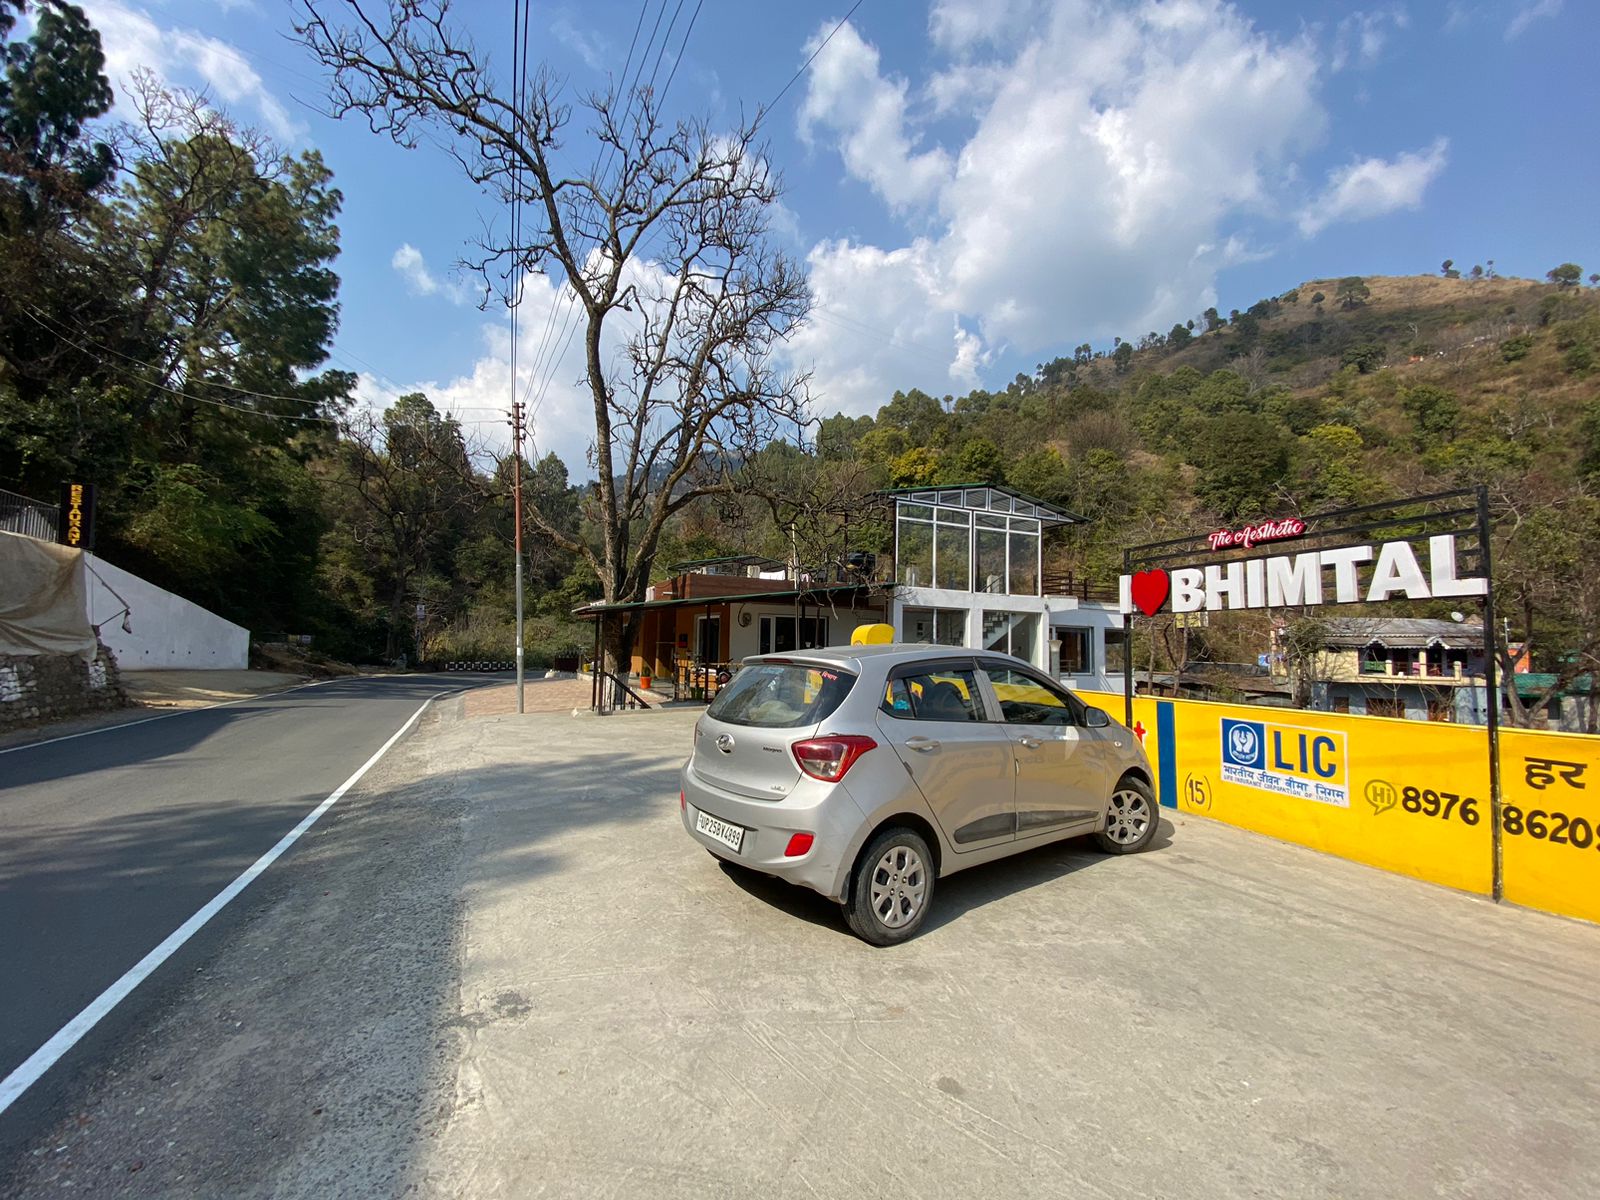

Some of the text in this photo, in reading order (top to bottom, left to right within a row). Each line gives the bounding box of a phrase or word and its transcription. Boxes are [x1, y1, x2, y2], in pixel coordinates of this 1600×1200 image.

[68, 484, 83, 545] RESTAURANT
[1208, 518, 1302, 550] The Aesthetic
[1119, 534, 1488, 614] I BHIMTAL
[1273, 730, 1336, 778] LIC
[1223, 764, 1345, 801] भारतीय जीवन बीमा निगम
[1524, 756, 1588, 790] हर
[1304, 791, 1312, 799] OF
[1372, 785, 1392, 805] Hi
[1401, 785, 1600, 853] 8976 8620
